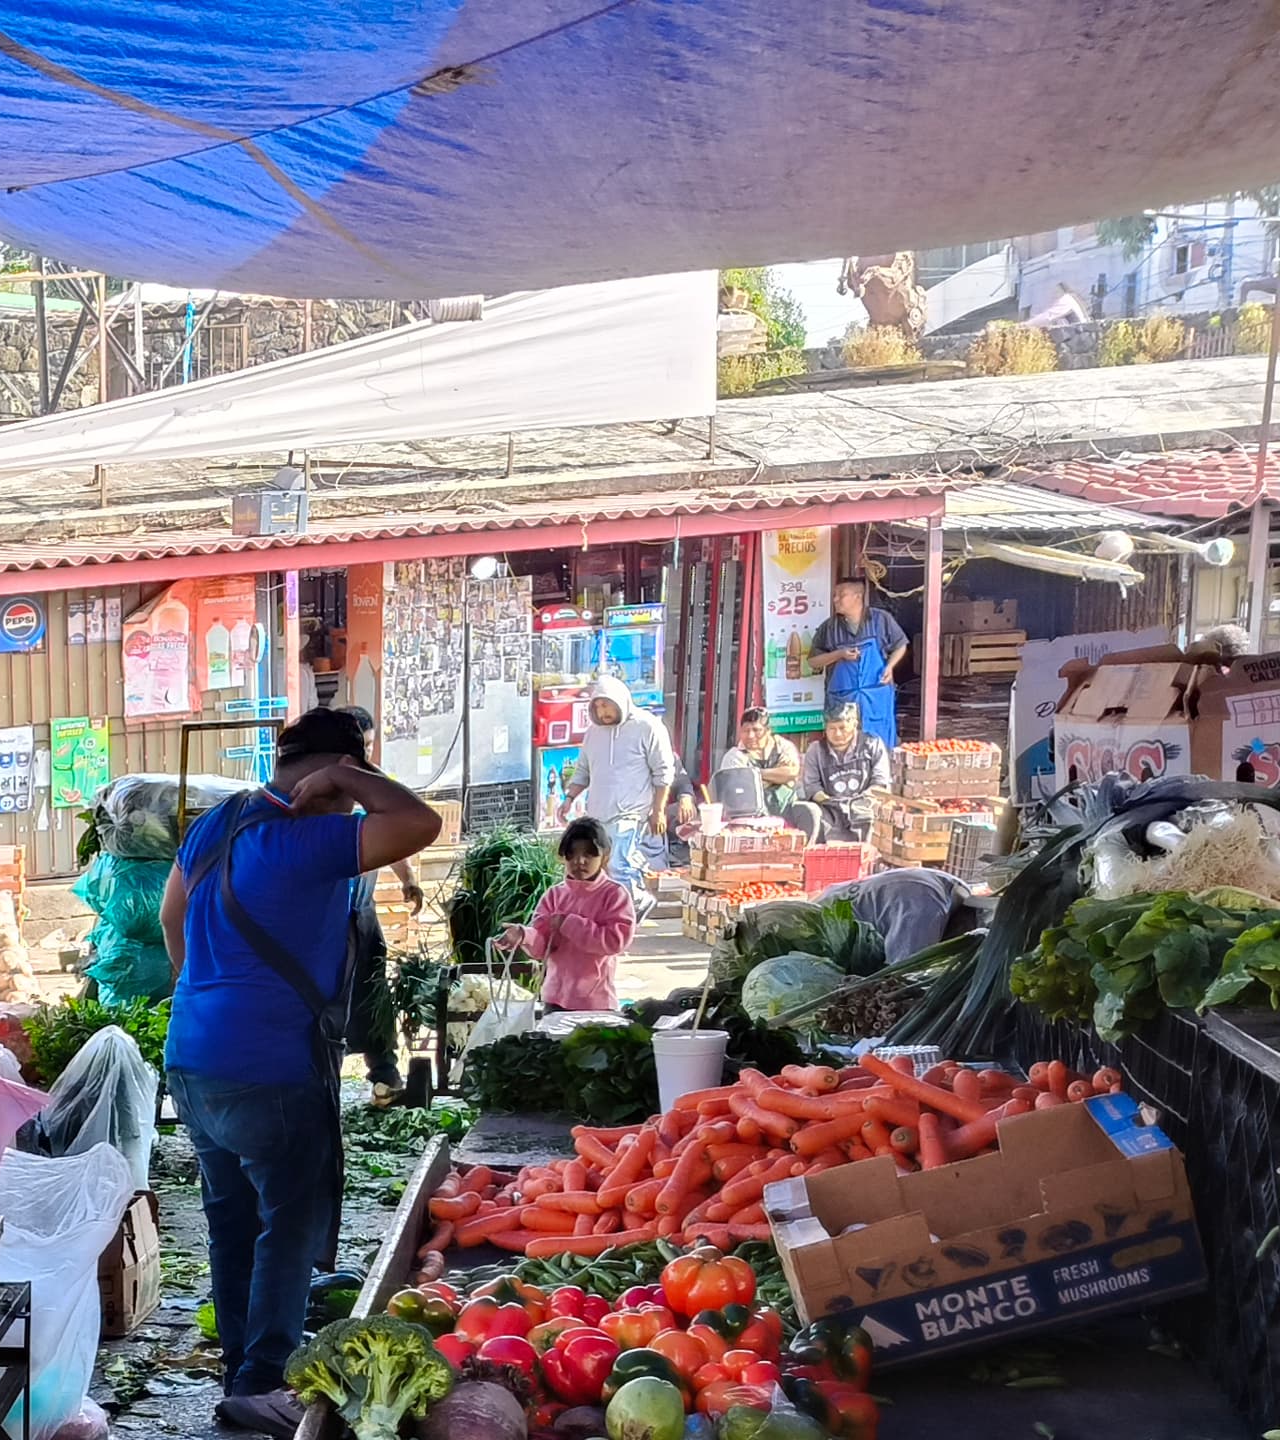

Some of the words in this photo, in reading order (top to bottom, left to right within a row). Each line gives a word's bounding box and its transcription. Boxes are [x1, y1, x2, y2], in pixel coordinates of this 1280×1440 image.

[778, 540, 817, 556] PRECIOS
[5, 614, 36, 627] PEPSI
[1243, 657, 1280, 673] PROD
[1052, 1259, 1100, 1284] FRESH
[914, 1275, 1032, 1321] MONTE
[1057, 1268, 1151, 1305] MUSHROOMS
[920, 1296, 1037, 1342] BLANCO
